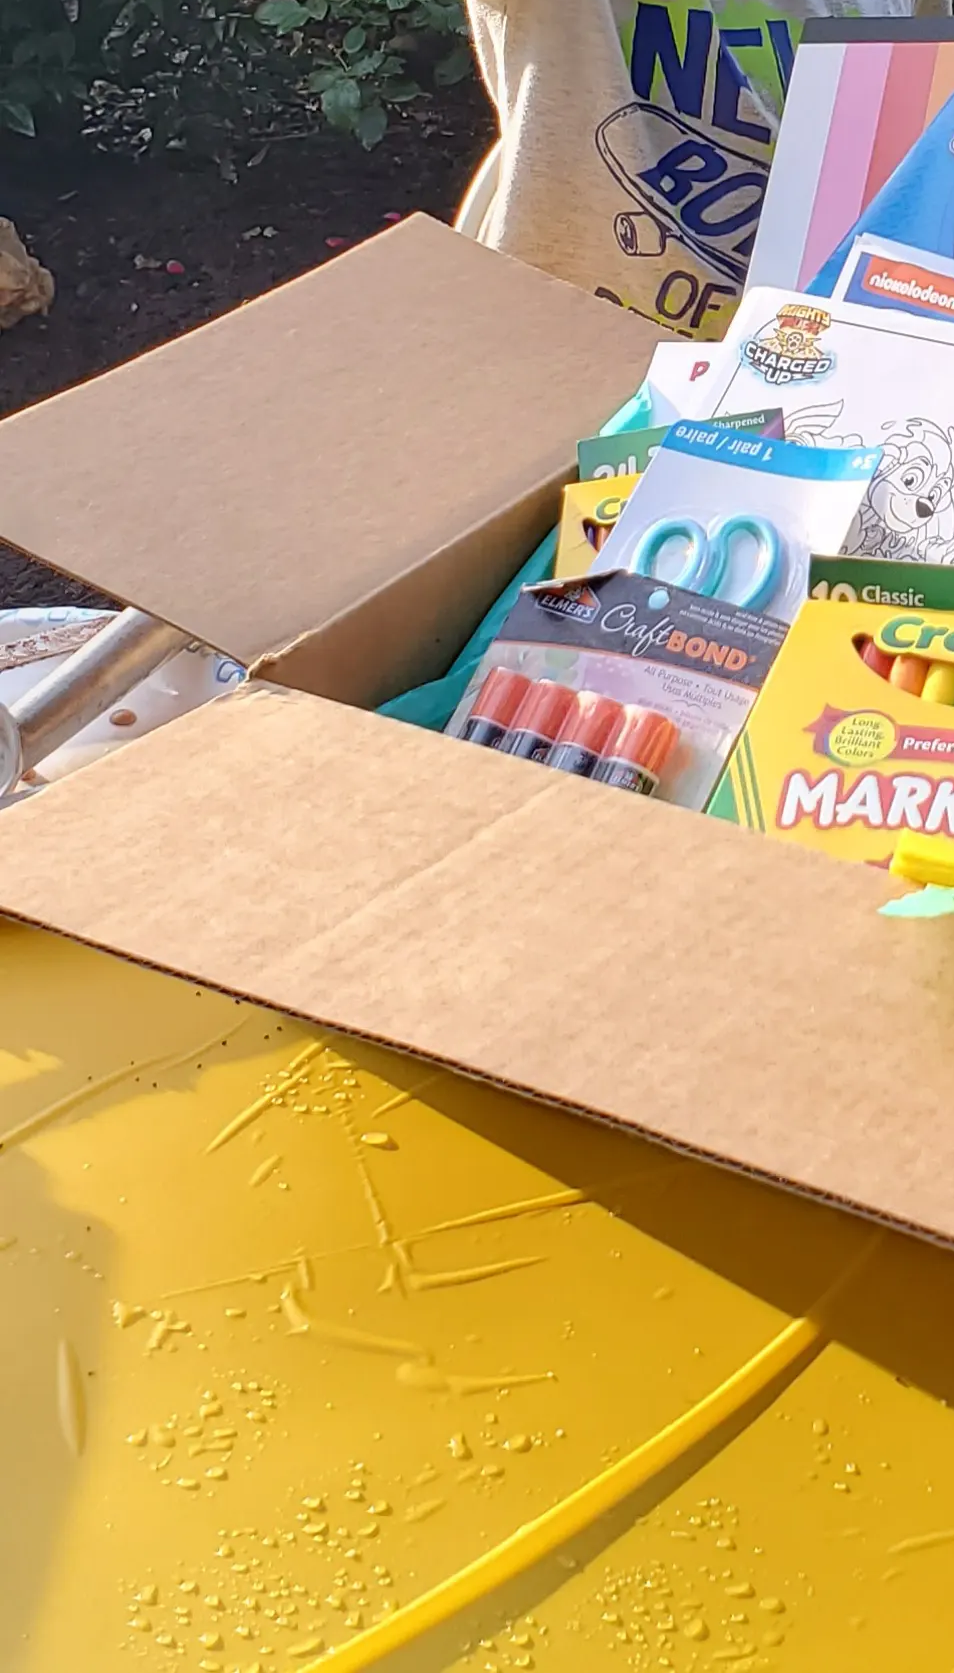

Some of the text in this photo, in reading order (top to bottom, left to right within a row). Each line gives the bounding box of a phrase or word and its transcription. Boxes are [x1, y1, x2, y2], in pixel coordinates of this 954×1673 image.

[655, 270, 737, 329] OF
[777, 304, 830, 327] MIGHTY
[744, 341, 832, 373] CHARGED
[765, 368, 793, 385] UP
[676, 425, 716, 446] paire
[728, 439, 762, 456] pair
[762, 447, 774, 462] 1
[862, 584, 925, 608] Classic
[541, 595, 594, 619] ELMER'S
[835, 736, 881, 751] Brilliant
[836, 746, 874, 760] Colors
